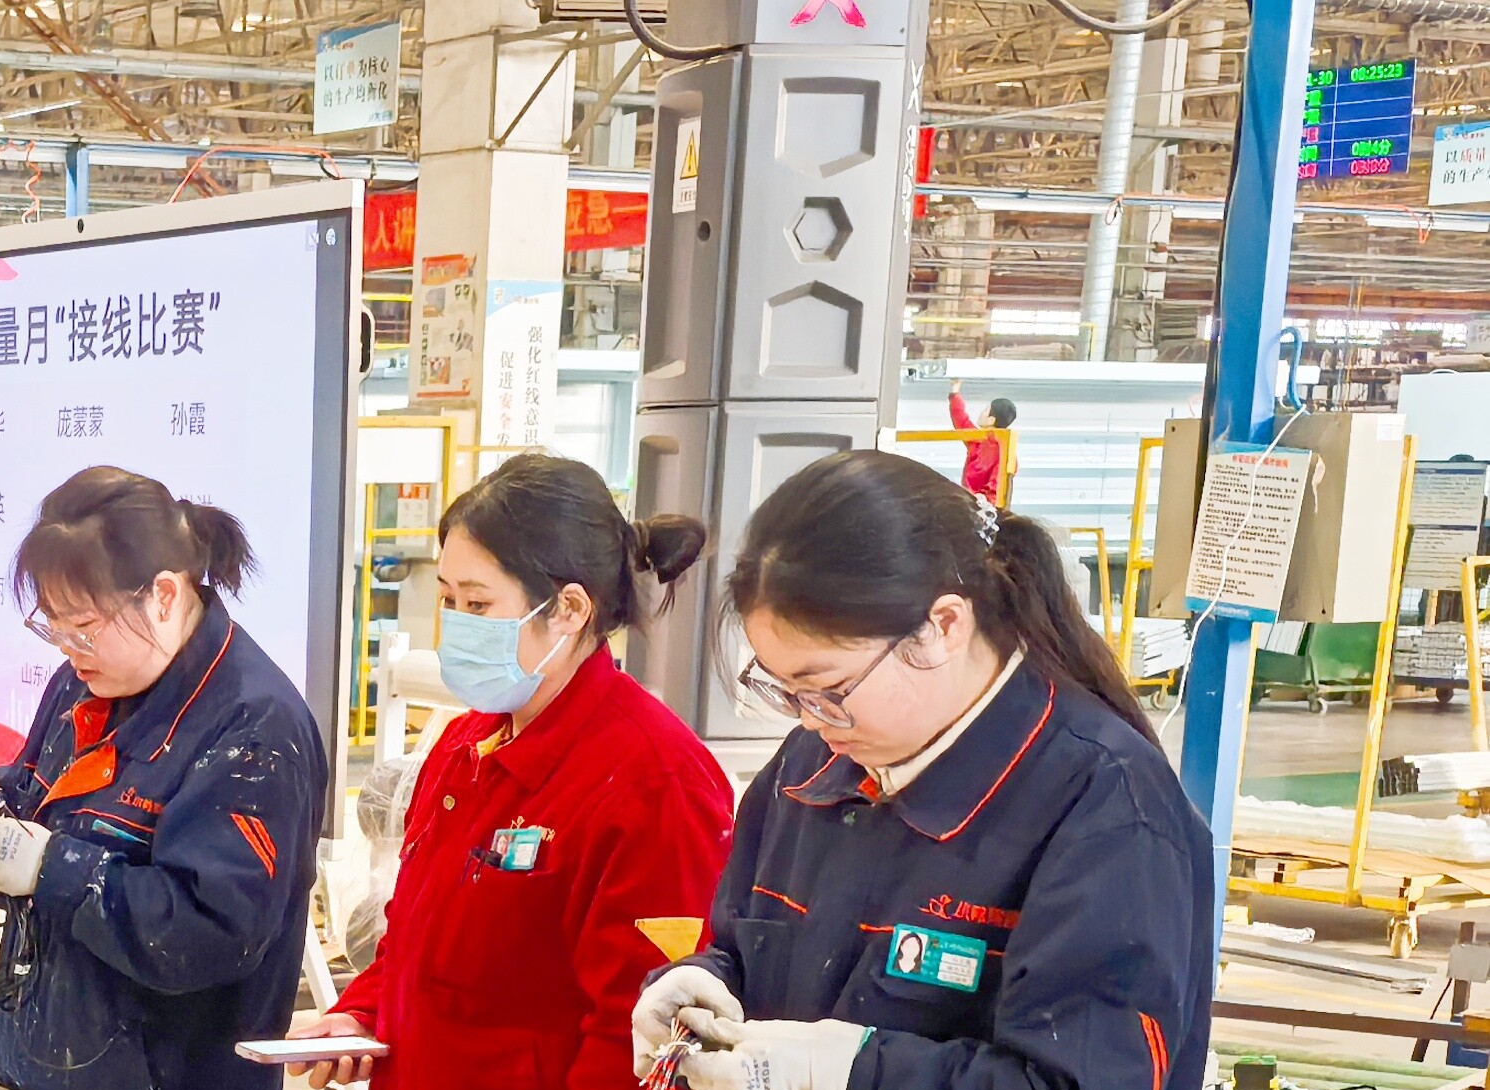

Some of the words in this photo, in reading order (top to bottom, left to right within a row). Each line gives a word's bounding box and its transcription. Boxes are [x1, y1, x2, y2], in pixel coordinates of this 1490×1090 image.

[171, 402, 206, 436] 孙霞
[523, 326, 542, 445] 强化红线意识
